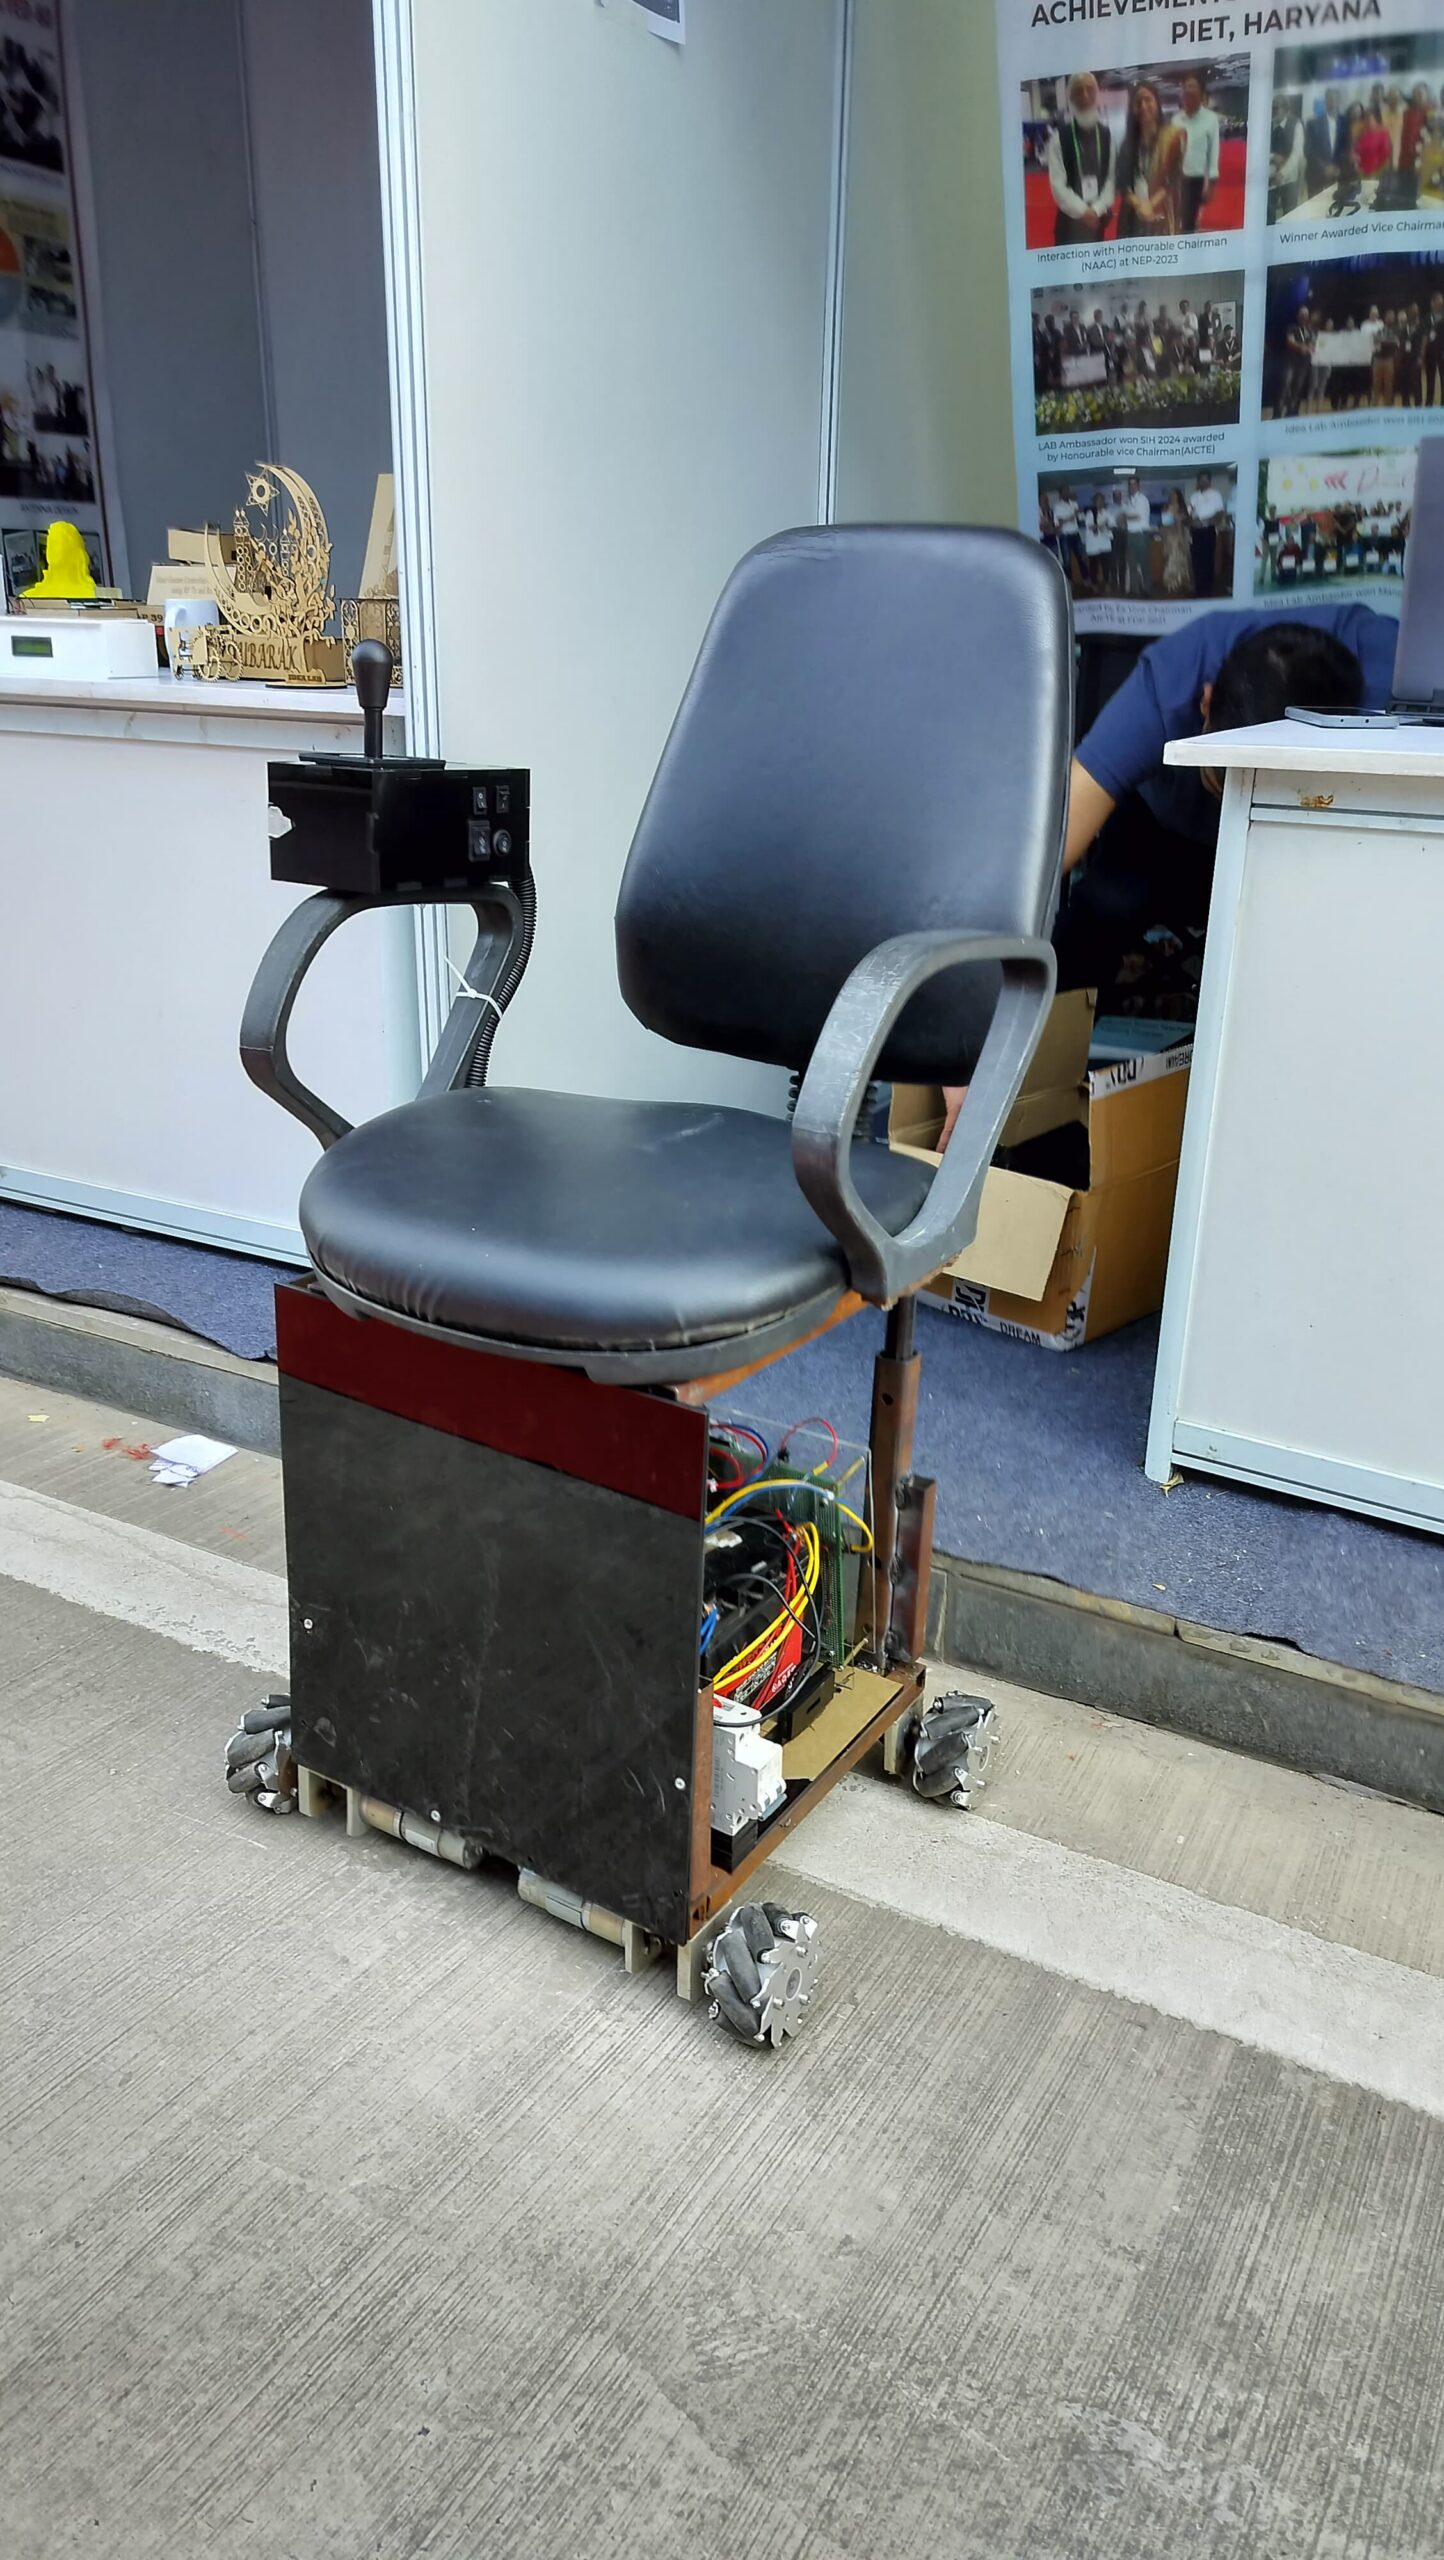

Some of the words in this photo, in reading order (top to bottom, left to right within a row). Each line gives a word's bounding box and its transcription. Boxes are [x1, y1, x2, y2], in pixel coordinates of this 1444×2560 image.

[1031, 0, 1236, 27] ACHIEVE
[1171, 16, 1235, 44] PIET,
[1244, 0, 1381, 35] HARYANA
[1279, 232, 1319, 244] Winner
[1320, 224, 1368, 239] Awarded
[1371, 221, 1394, 233] Vice
[1037, 249, 1090, 263] Interaction
[1093, 246, 1115, 257] with
[1118, 241, 1175, 254] Honourable
[1177, 237, 1227, 250] Chairman
[1081, 258, 1117, 273] (NAAC)
[1119, 256, 1129, 267] at
[1132, 254, 1179, 266] NEP-2023
[1038, 441, 1057, 451] LAB
[1059, 436, 1117, 450] Ambassador
[1119, 437, 1138, 445] won
[1140, 435, 1156, 444] SIH
[1158, 435, 1181, 444] 2024
[1183, 432, 1225, 443] awarded
[1047, 453, 1058, 462] by
[1060, 448, 1114, 461] Honourable
[1116, 447, 1135, 456] vice
[1136, 444, 1216, 457] Chairman(AICTE)
[150, 614, 164, 623] 39
[238, 641, 299, 671] UBARAK
[1000, 1321, 1041, 1346] DREAM
